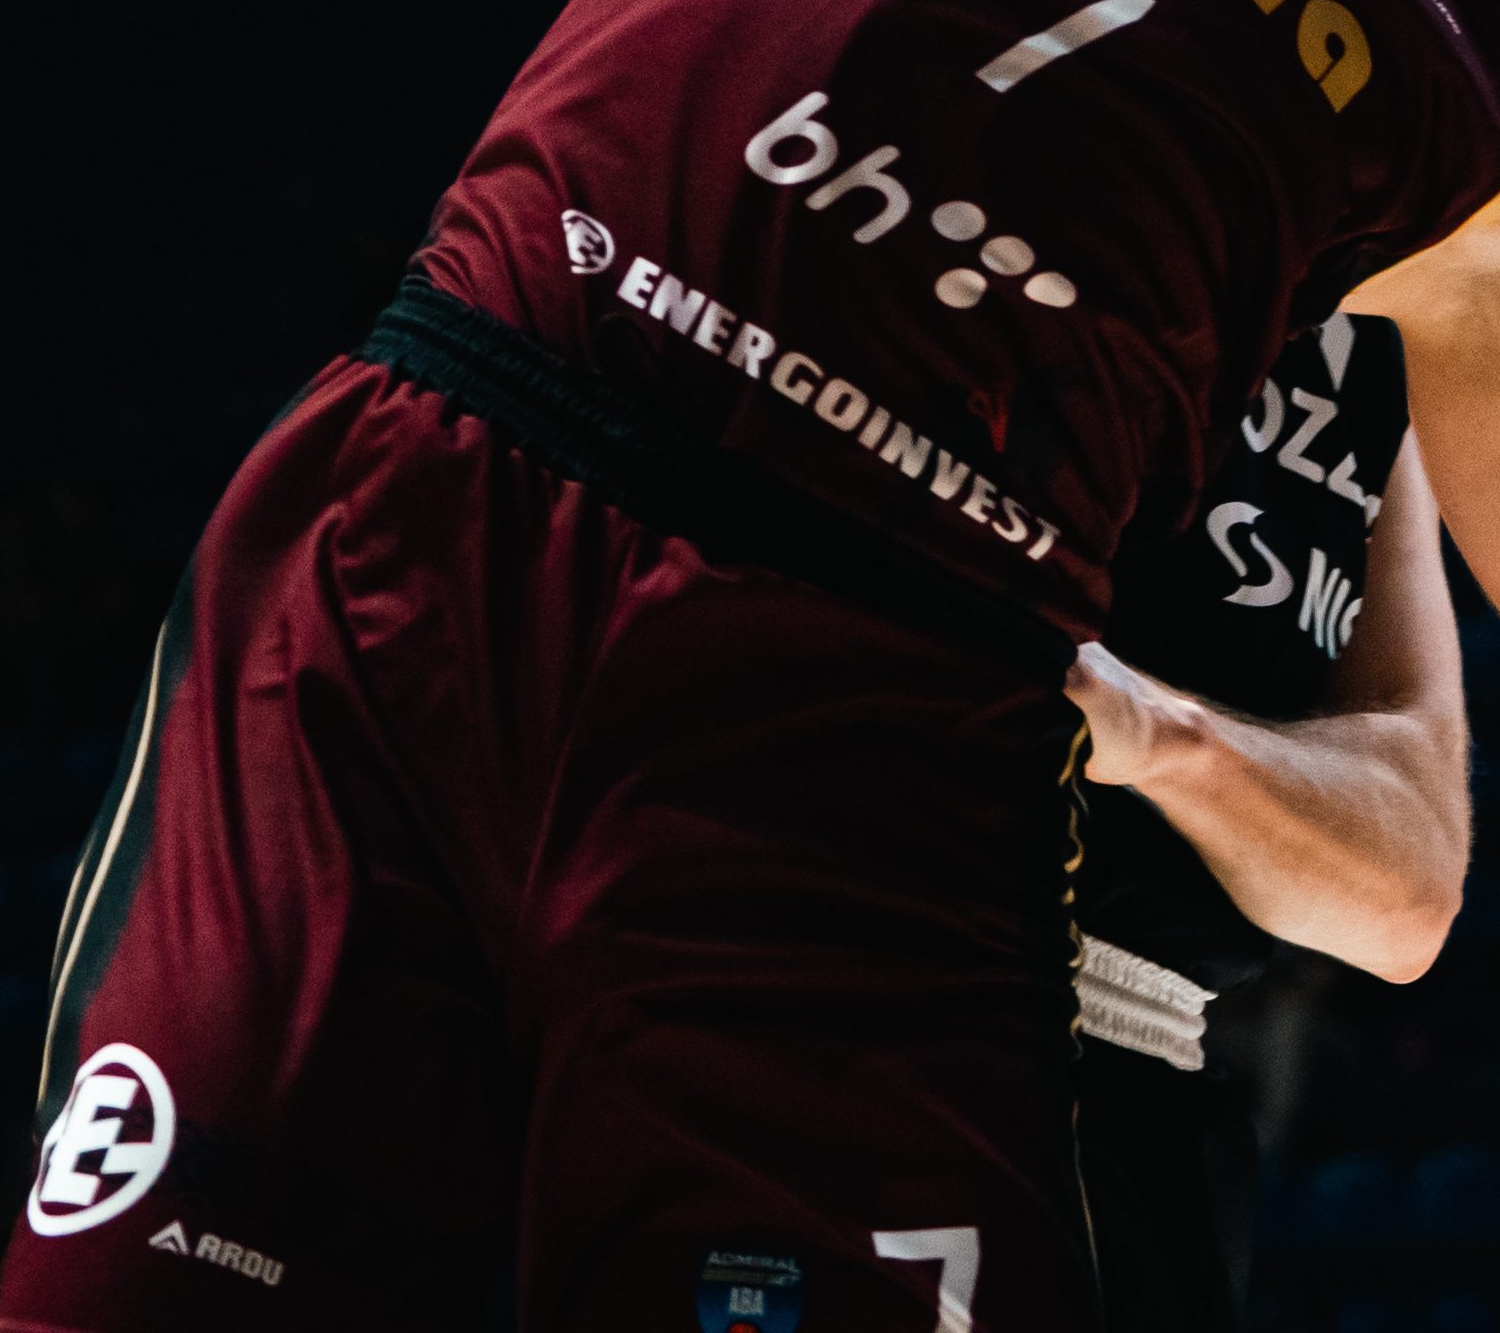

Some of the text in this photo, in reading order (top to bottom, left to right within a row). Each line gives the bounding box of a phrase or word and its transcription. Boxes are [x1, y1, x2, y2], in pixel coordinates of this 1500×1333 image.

[616, 256, 1062, 561] ENERGOINVEST
[194, 1233, 286, 1288] ARDU
[871, 1226, 981, 1333] 7
